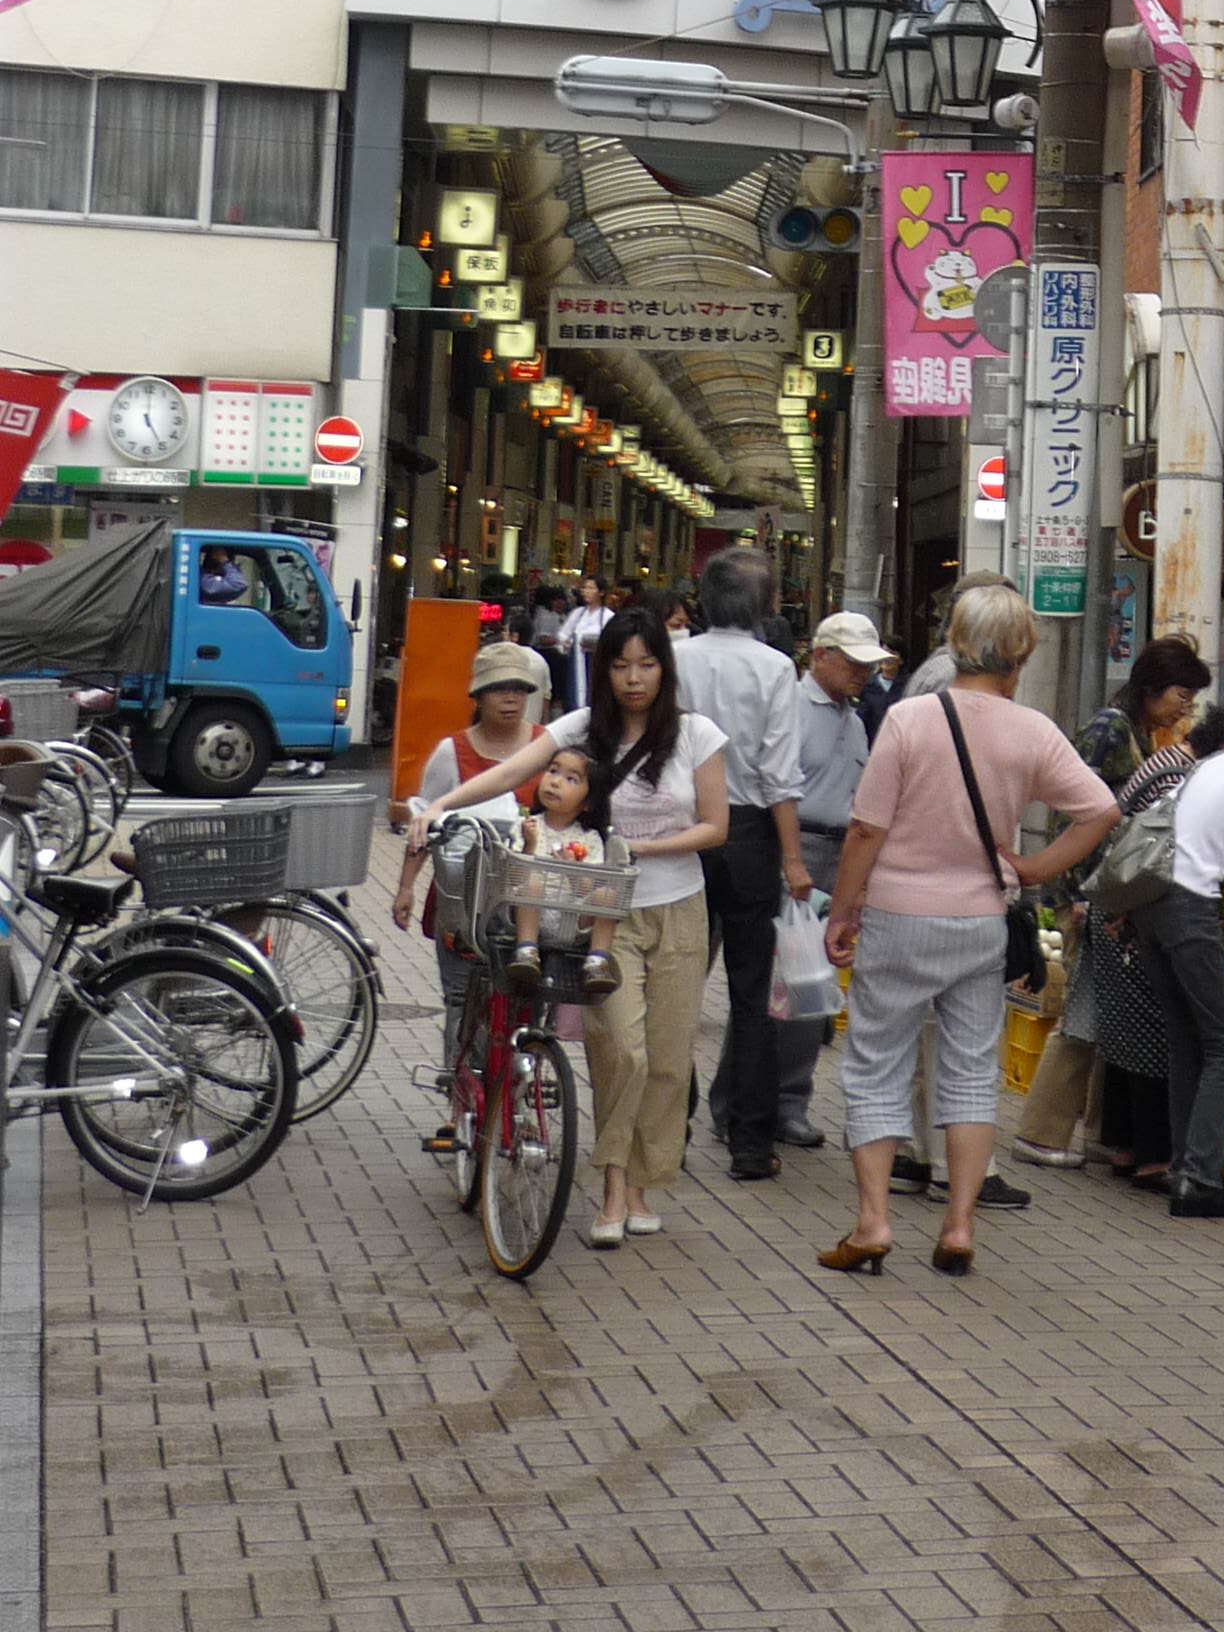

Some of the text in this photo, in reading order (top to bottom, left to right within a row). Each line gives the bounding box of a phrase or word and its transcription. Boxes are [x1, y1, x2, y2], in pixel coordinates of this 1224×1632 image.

[1048, 336, 1086, 507] 原クリニック
